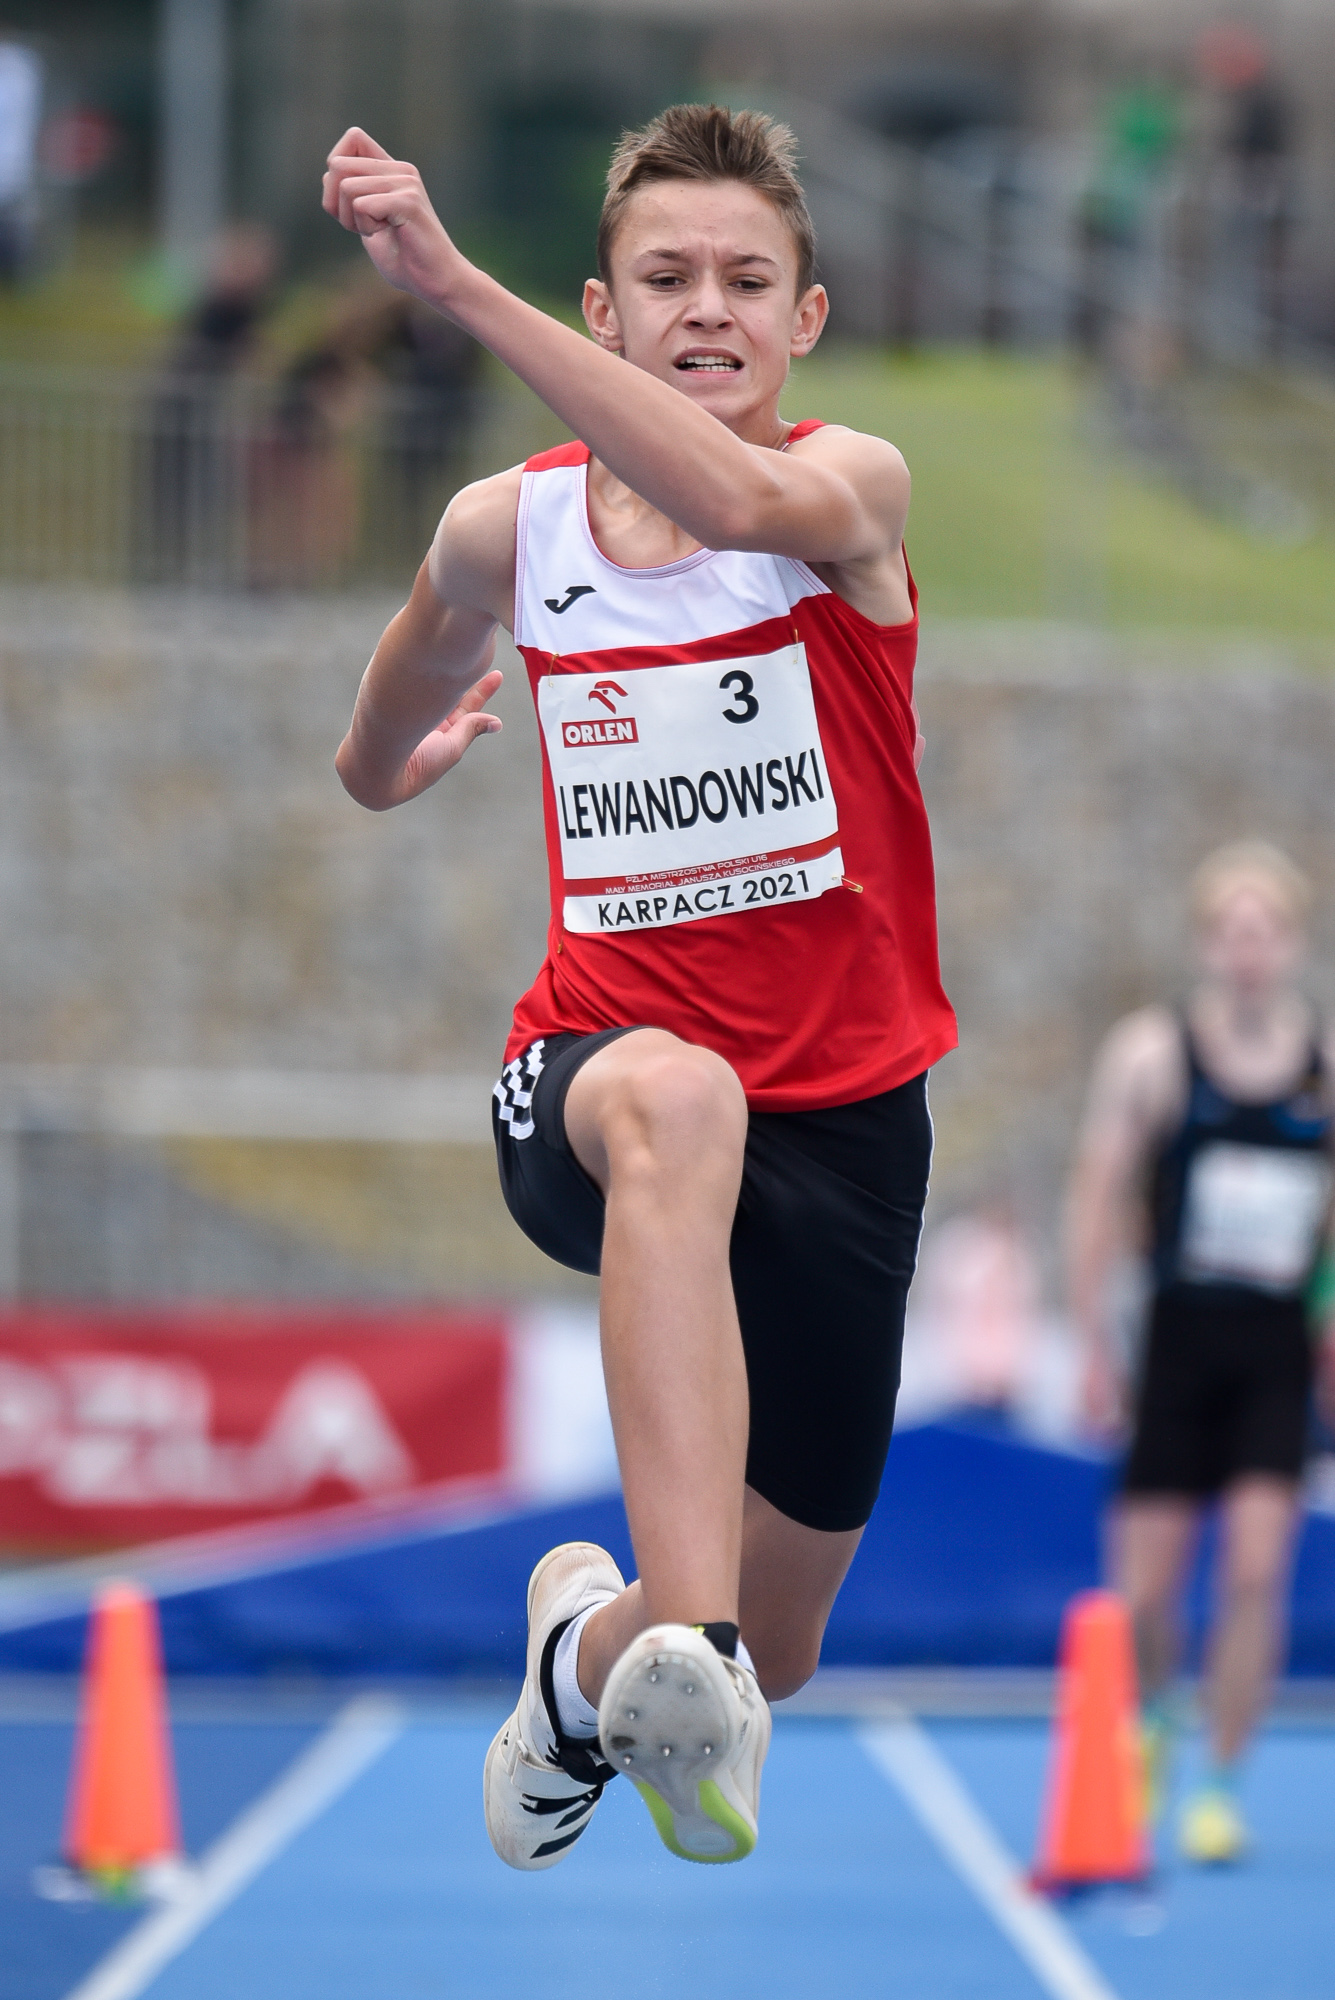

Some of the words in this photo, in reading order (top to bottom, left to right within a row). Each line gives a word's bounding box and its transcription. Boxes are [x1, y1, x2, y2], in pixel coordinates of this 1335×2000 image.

[719, 669, 759, 725] 3
[564, 721, 634, 745] ORLEN
[559, 747, 825, 839] LEWANDOWSKI
[625, 875, 649, 884] PZLA
[650, 865, 716, 881] MISTRZOSTWA
[717, 858, 750, 870] POLSKI
[751, 854, 768, 863] U16
[677, 872, 722, 886] JANUSZA
[597, 884, 735, 927] KARPACZ
[742, 869, 811, 904] 2021
